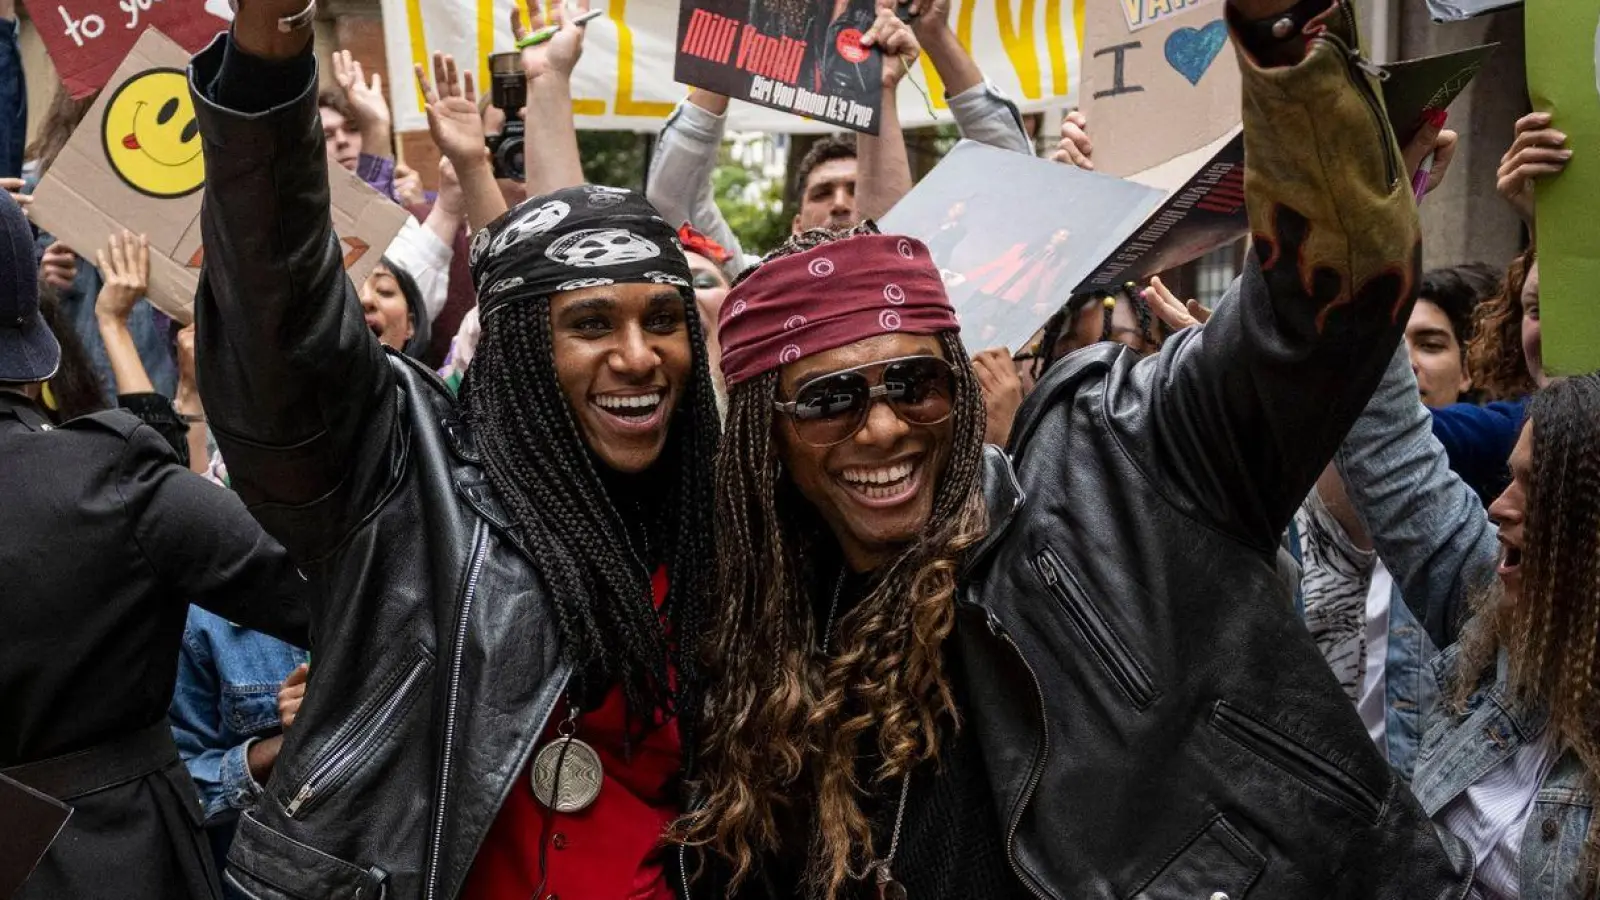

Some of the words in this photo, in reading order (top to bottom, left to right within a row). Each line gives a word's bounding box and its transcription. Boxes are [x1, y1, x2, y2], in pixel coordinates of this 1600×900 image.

[58, 5, 105, 47] to
[681, 8, 739, 64] Milli
[736, 24, 807, 84] Vanilli
[1093, 41, 1145, 100] I
[749, 74, 774, 102] Girl
[772, 82, 796, 108] You
[793, 87, 829, 117] Know
[826, 95, 848, 122] It's
[846, 100, 873, 128] True
